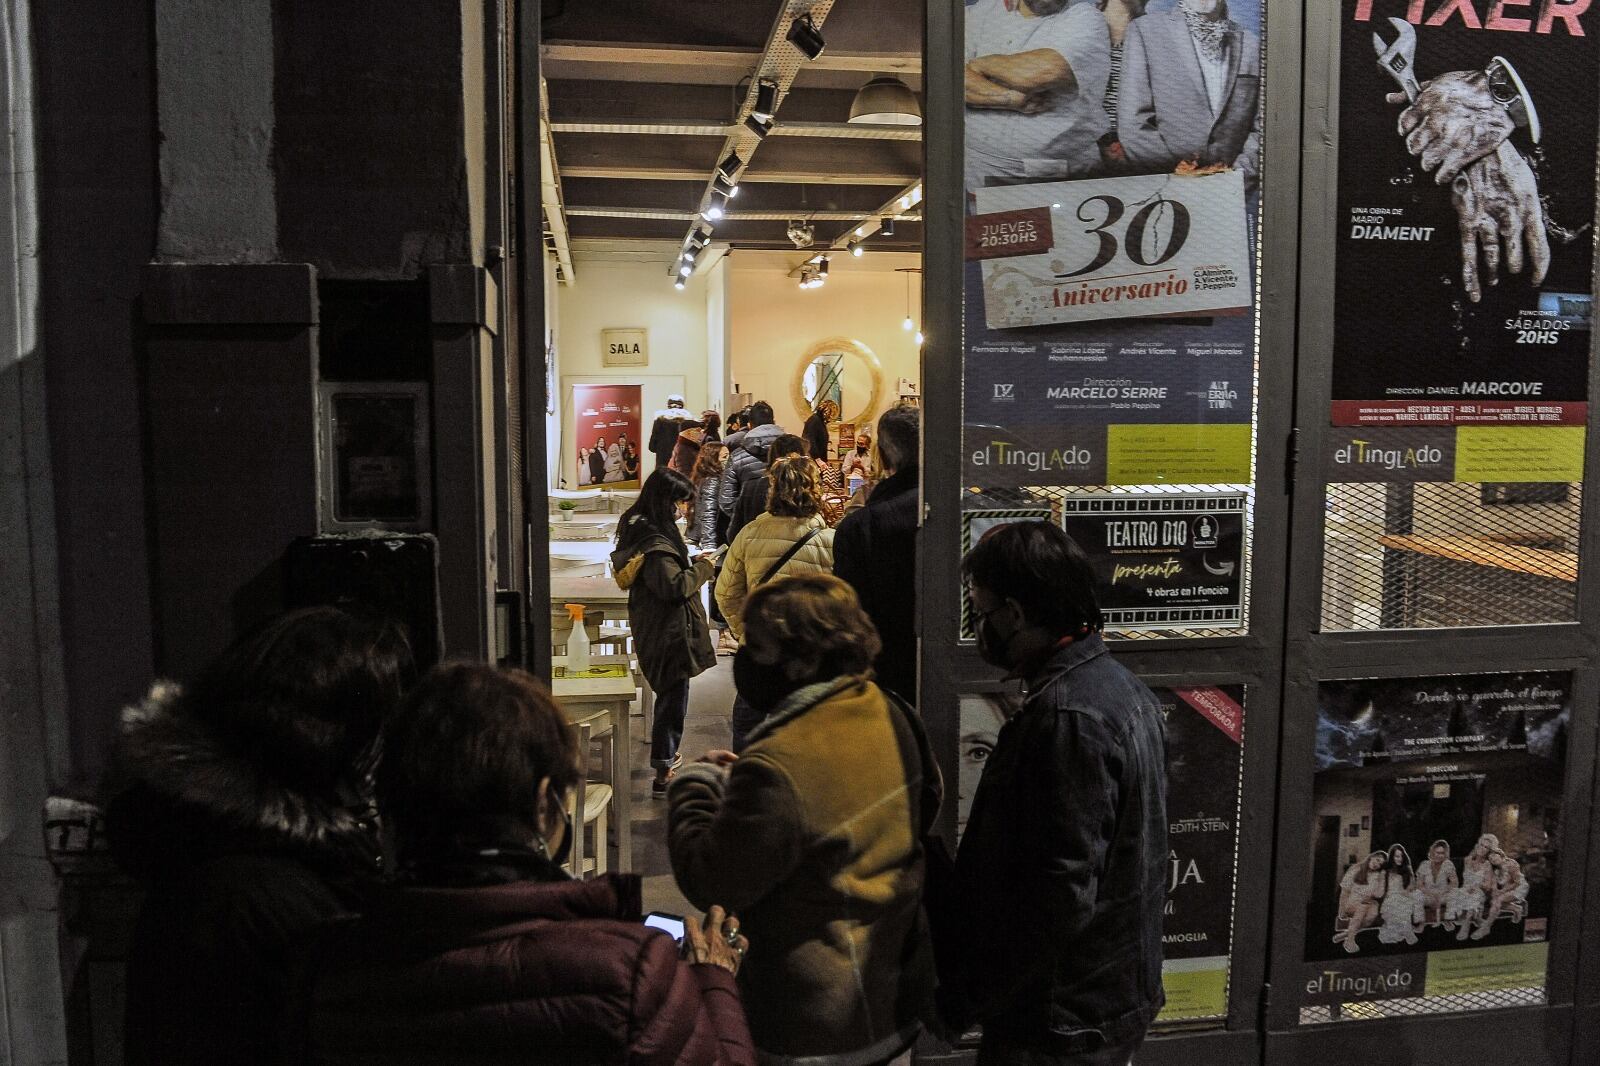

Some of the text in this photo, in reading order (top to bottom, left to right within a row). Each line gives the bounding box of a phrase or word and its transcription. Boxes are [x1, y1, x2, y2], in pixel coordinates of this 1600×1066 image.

[1351, 215, 1384, 224] MARIO
[982, 221, 1034, 236] JUEVES
[1351, 225, 1435, 241] DIAMENT
[981, 231, 1037, 248] 20:30HS
[1055, 195, 1190, 278] 30
[1052, 274, 1188, 307] Aniversario
[1504, 316, 1571, 331] SÁBADOS
[1516, 330, 1559, 344] 20HS
[609, 343, 640, 354] SALA
[1083, 377, 1132, 387] Dirección
[1426, 387, 1460, 395] DANIEL
[1461, 381, 1543, 395] MARCOVE
[1046, 387, 1168, 399] MARCELO SERRE
[972, 446, 990, 466] el
[1335, 445, 1351, 463] el
[1105, 521, 1187, 546] TEATRO D10
[1112, 557, 1183, 585] presenta
[1147, 587, 1153, 596] 4
[1155, 587, 1180, 596] obras
[1181, 587, 1191, 596] en
[1191, 690, 1235, 731] TEMPORADA
[1170, 821, 1230, 834] EDITH STEIN
[1306, 976, 1323, 994] el
